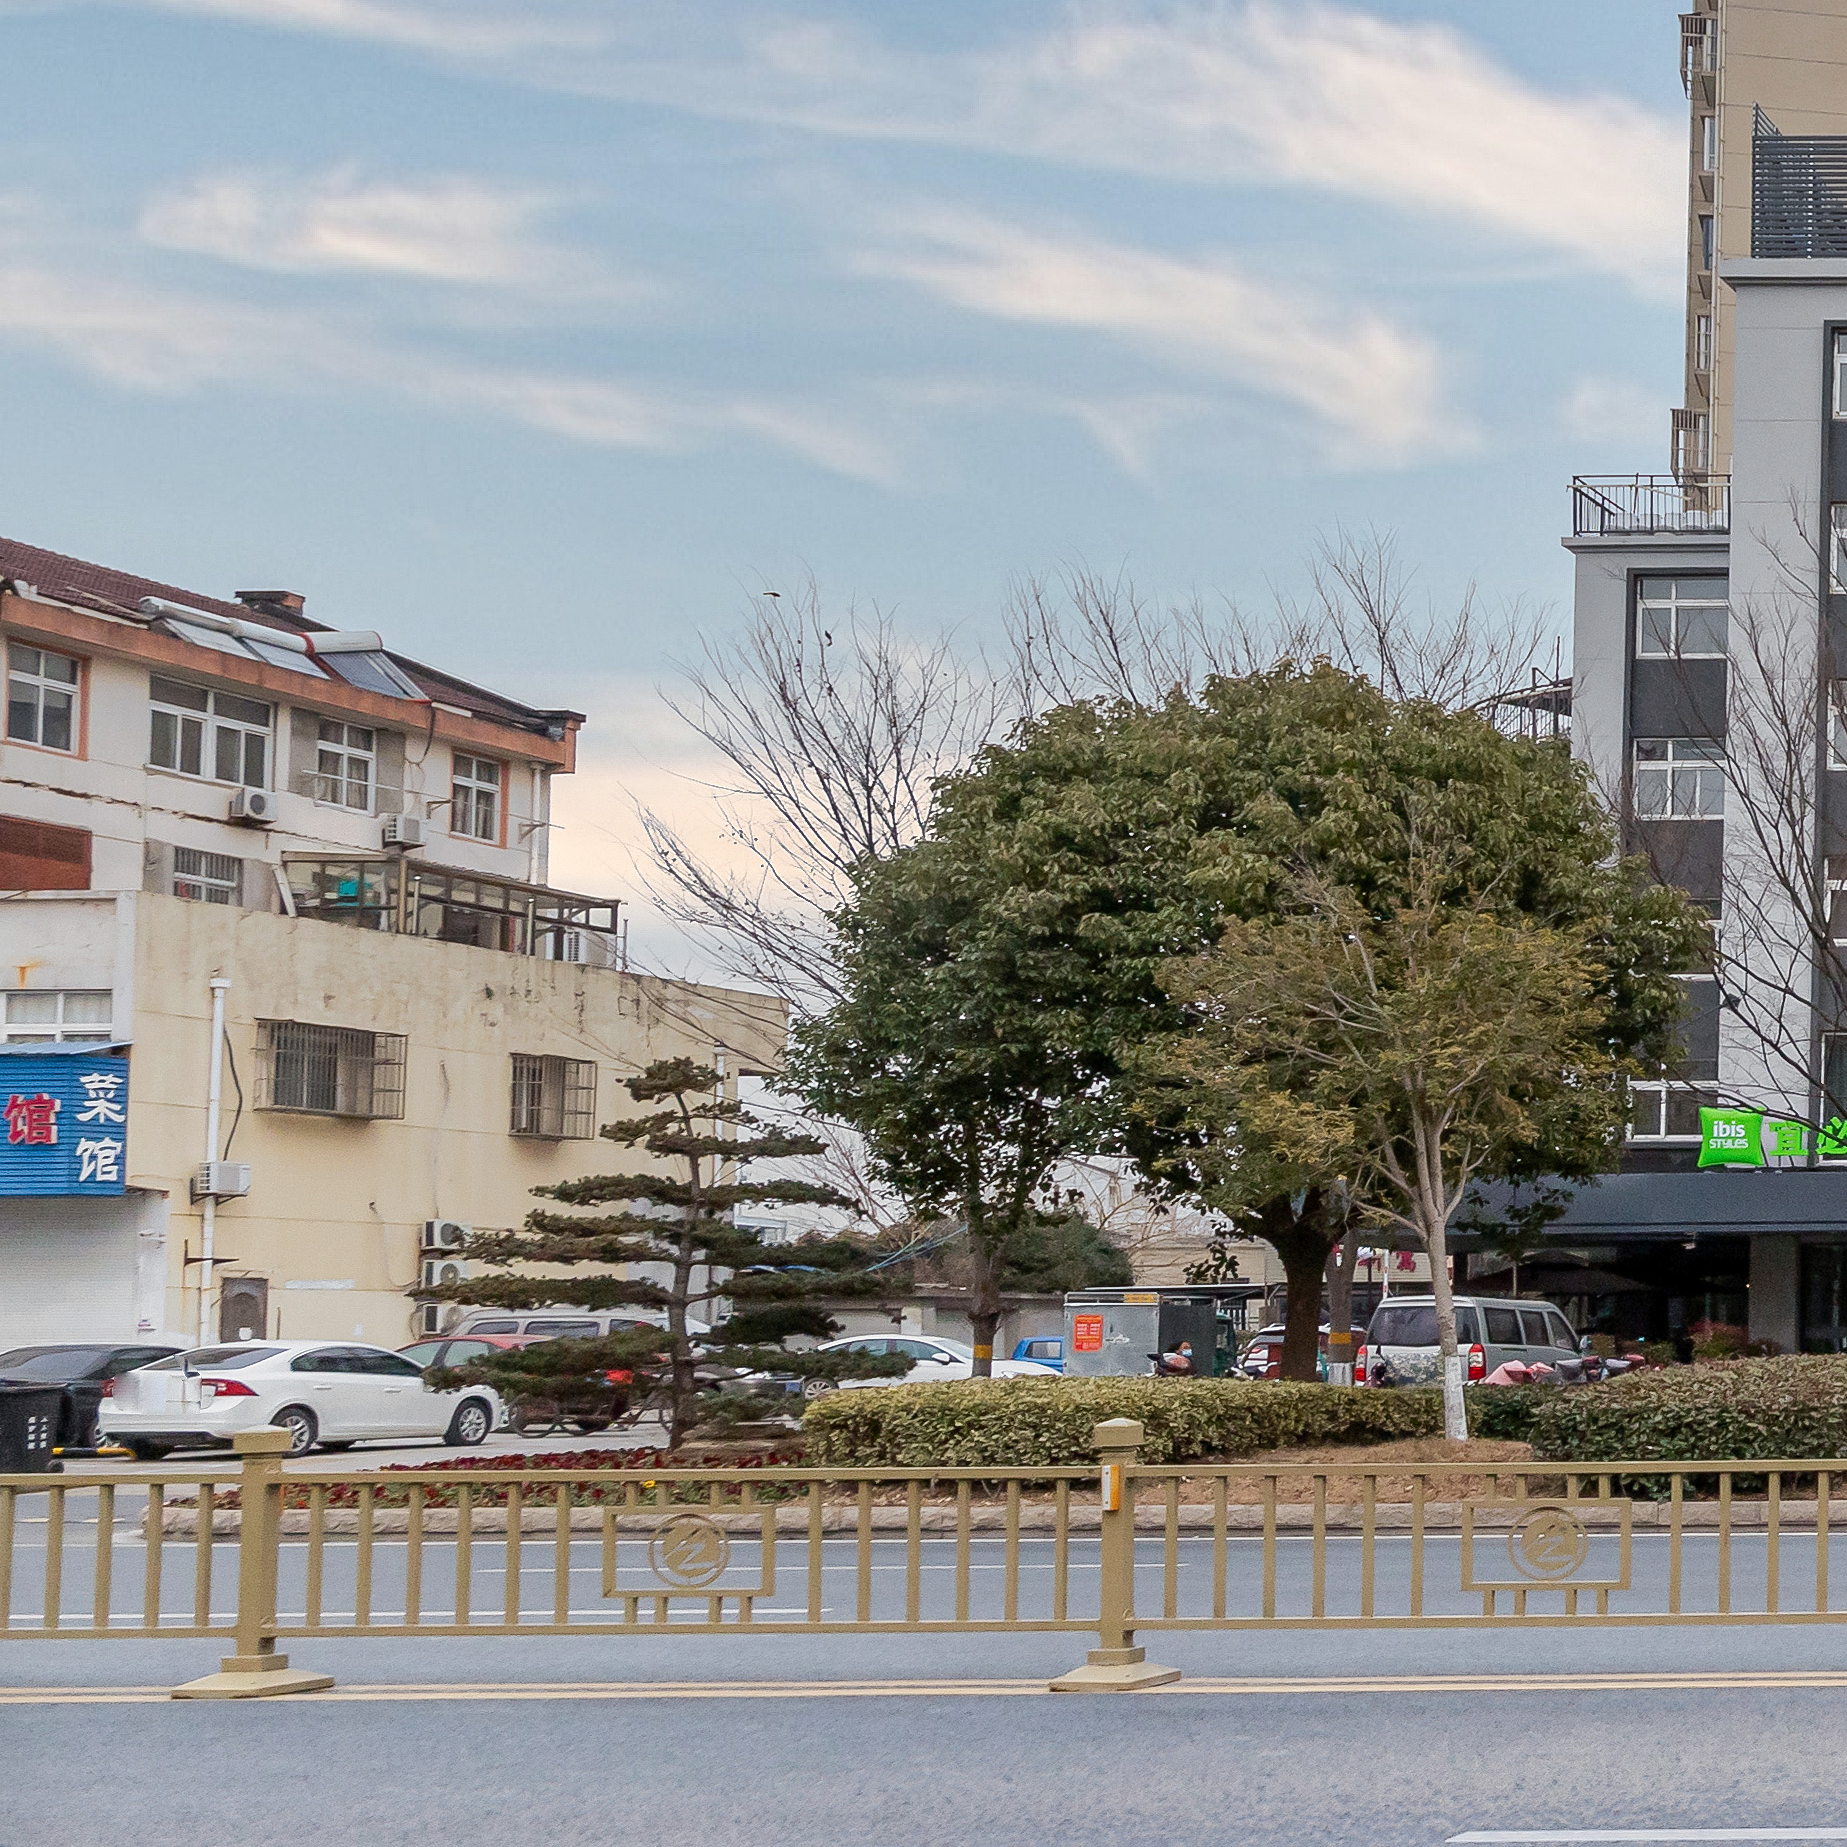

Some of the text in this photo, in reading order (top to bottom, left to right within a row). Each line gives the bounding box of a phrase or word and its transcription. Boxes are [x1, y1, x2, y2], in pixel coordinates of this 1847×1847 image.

[3, 1092, 62, 1144] 馆
[76, 1073, 125, 1182] 菜馆
[1712, 1120, 1746, 1137] ibis
